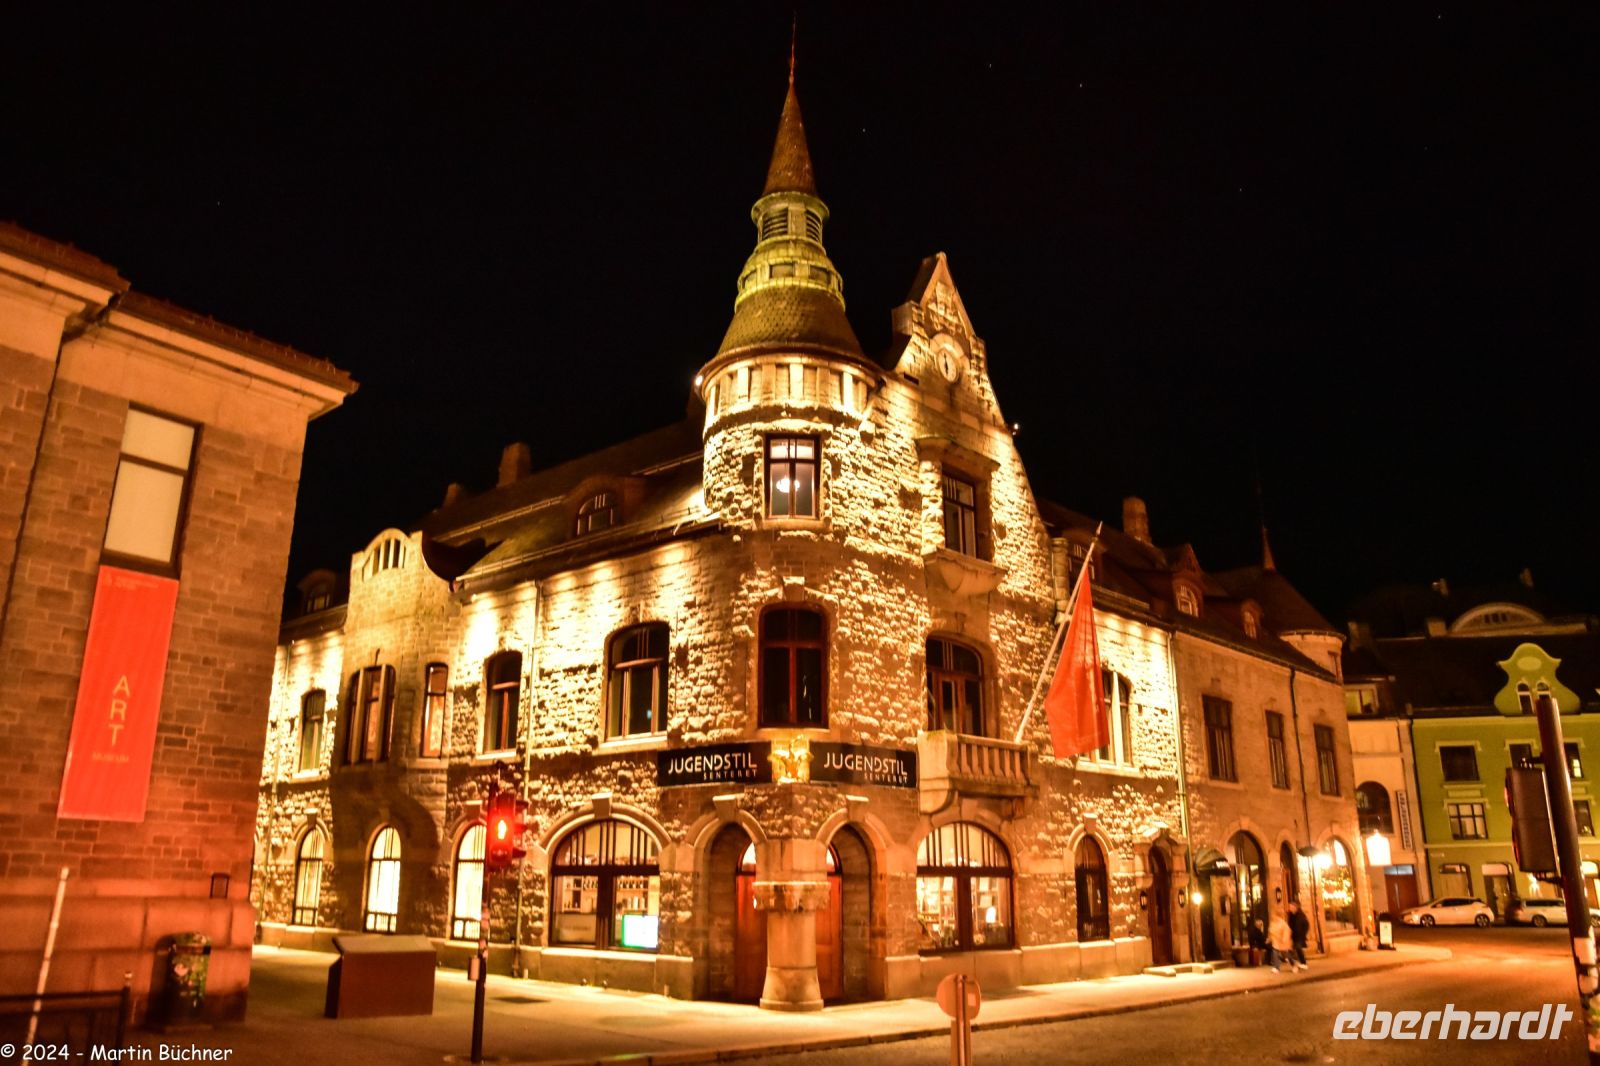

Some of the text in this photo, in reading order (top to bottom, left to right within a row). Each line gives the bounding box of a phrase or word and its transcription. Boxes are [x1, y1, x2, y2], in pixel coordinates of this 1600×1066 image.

[109, 674, 130, 746] ART
[668, 752, 757, 774] JUGENDSTIL
[823, 752, 908, 776] JUGENDSTIL
[703, 769, 757, 780] SENTERET
[864, 772, 908, 784] SENTERET
